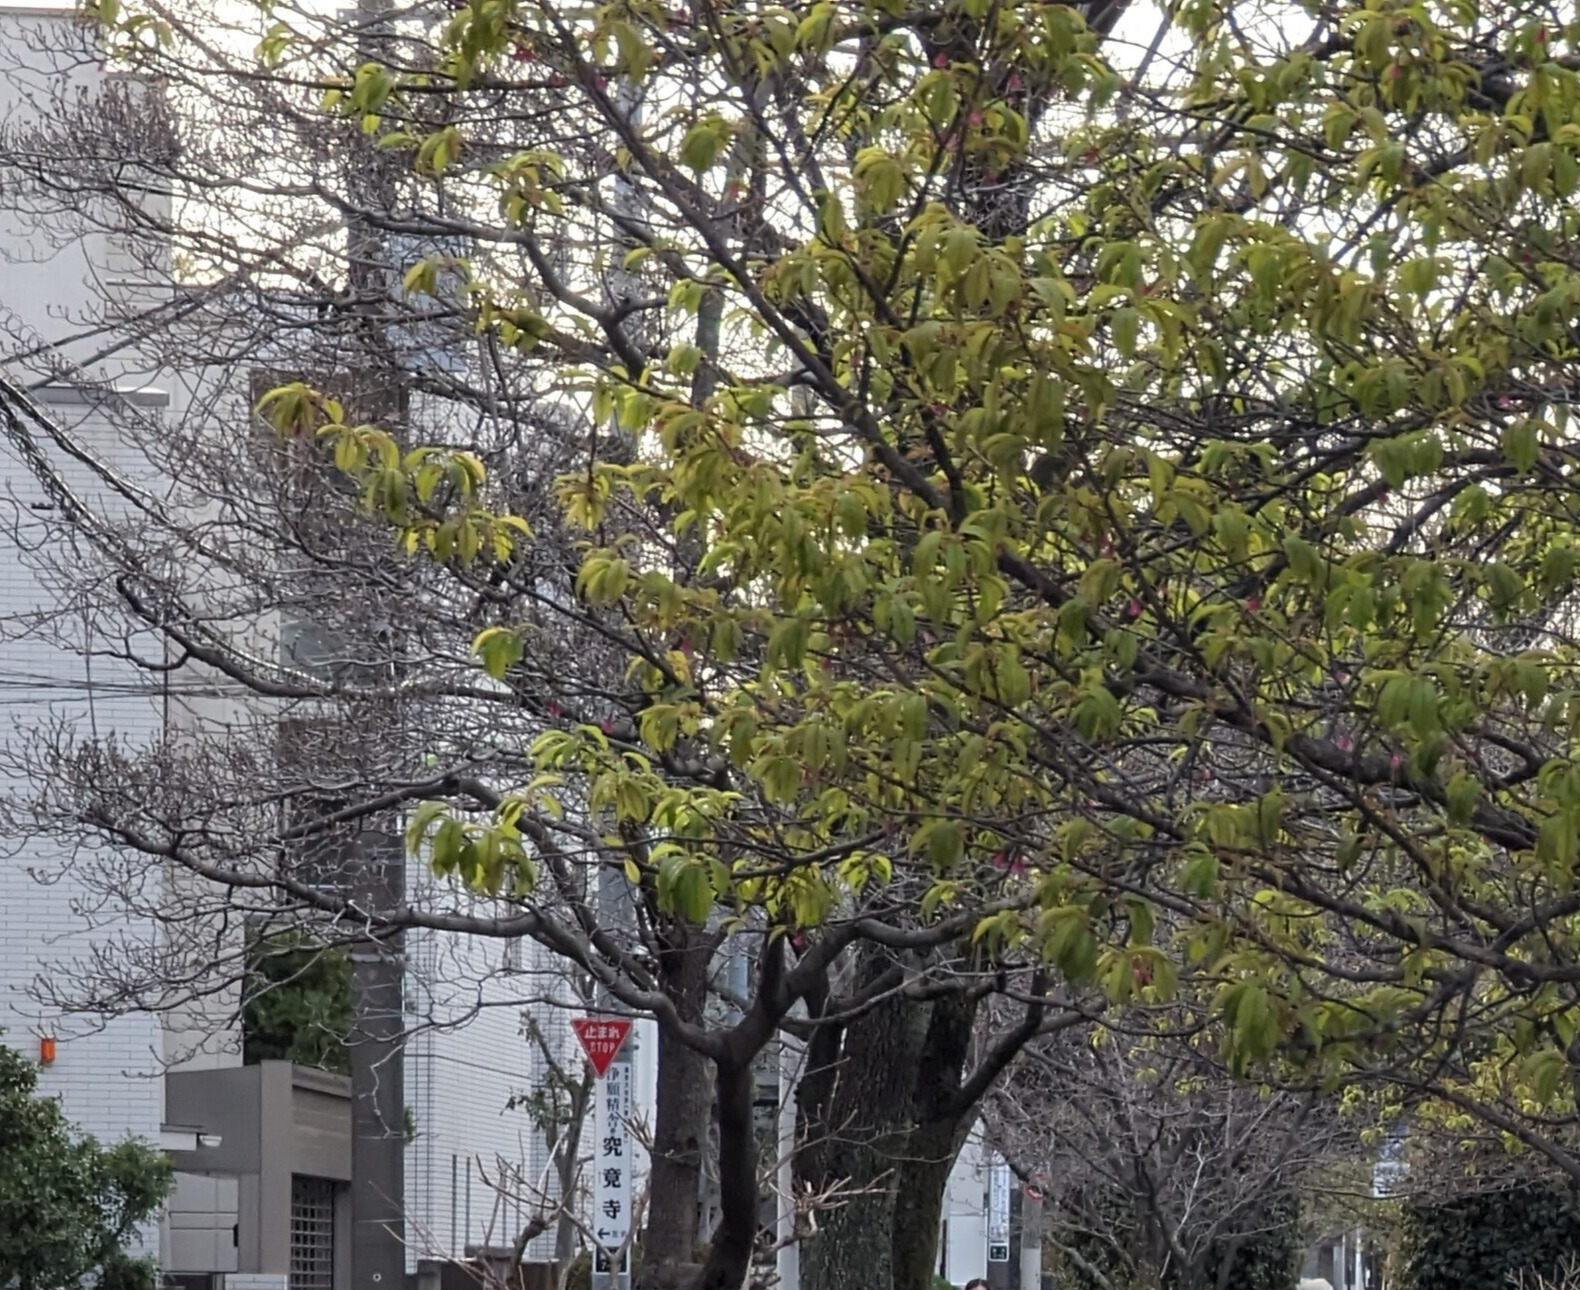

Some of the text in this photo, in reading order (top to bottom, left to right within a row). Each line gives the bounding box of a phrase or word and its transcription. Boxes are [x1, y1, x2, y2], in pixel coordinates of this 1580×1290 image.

[584, 1025, 620, 1039] 止まれ
[589, 1042, 616, 1053] STOP
[602, 1136, 623, 1220] 究竟寺
